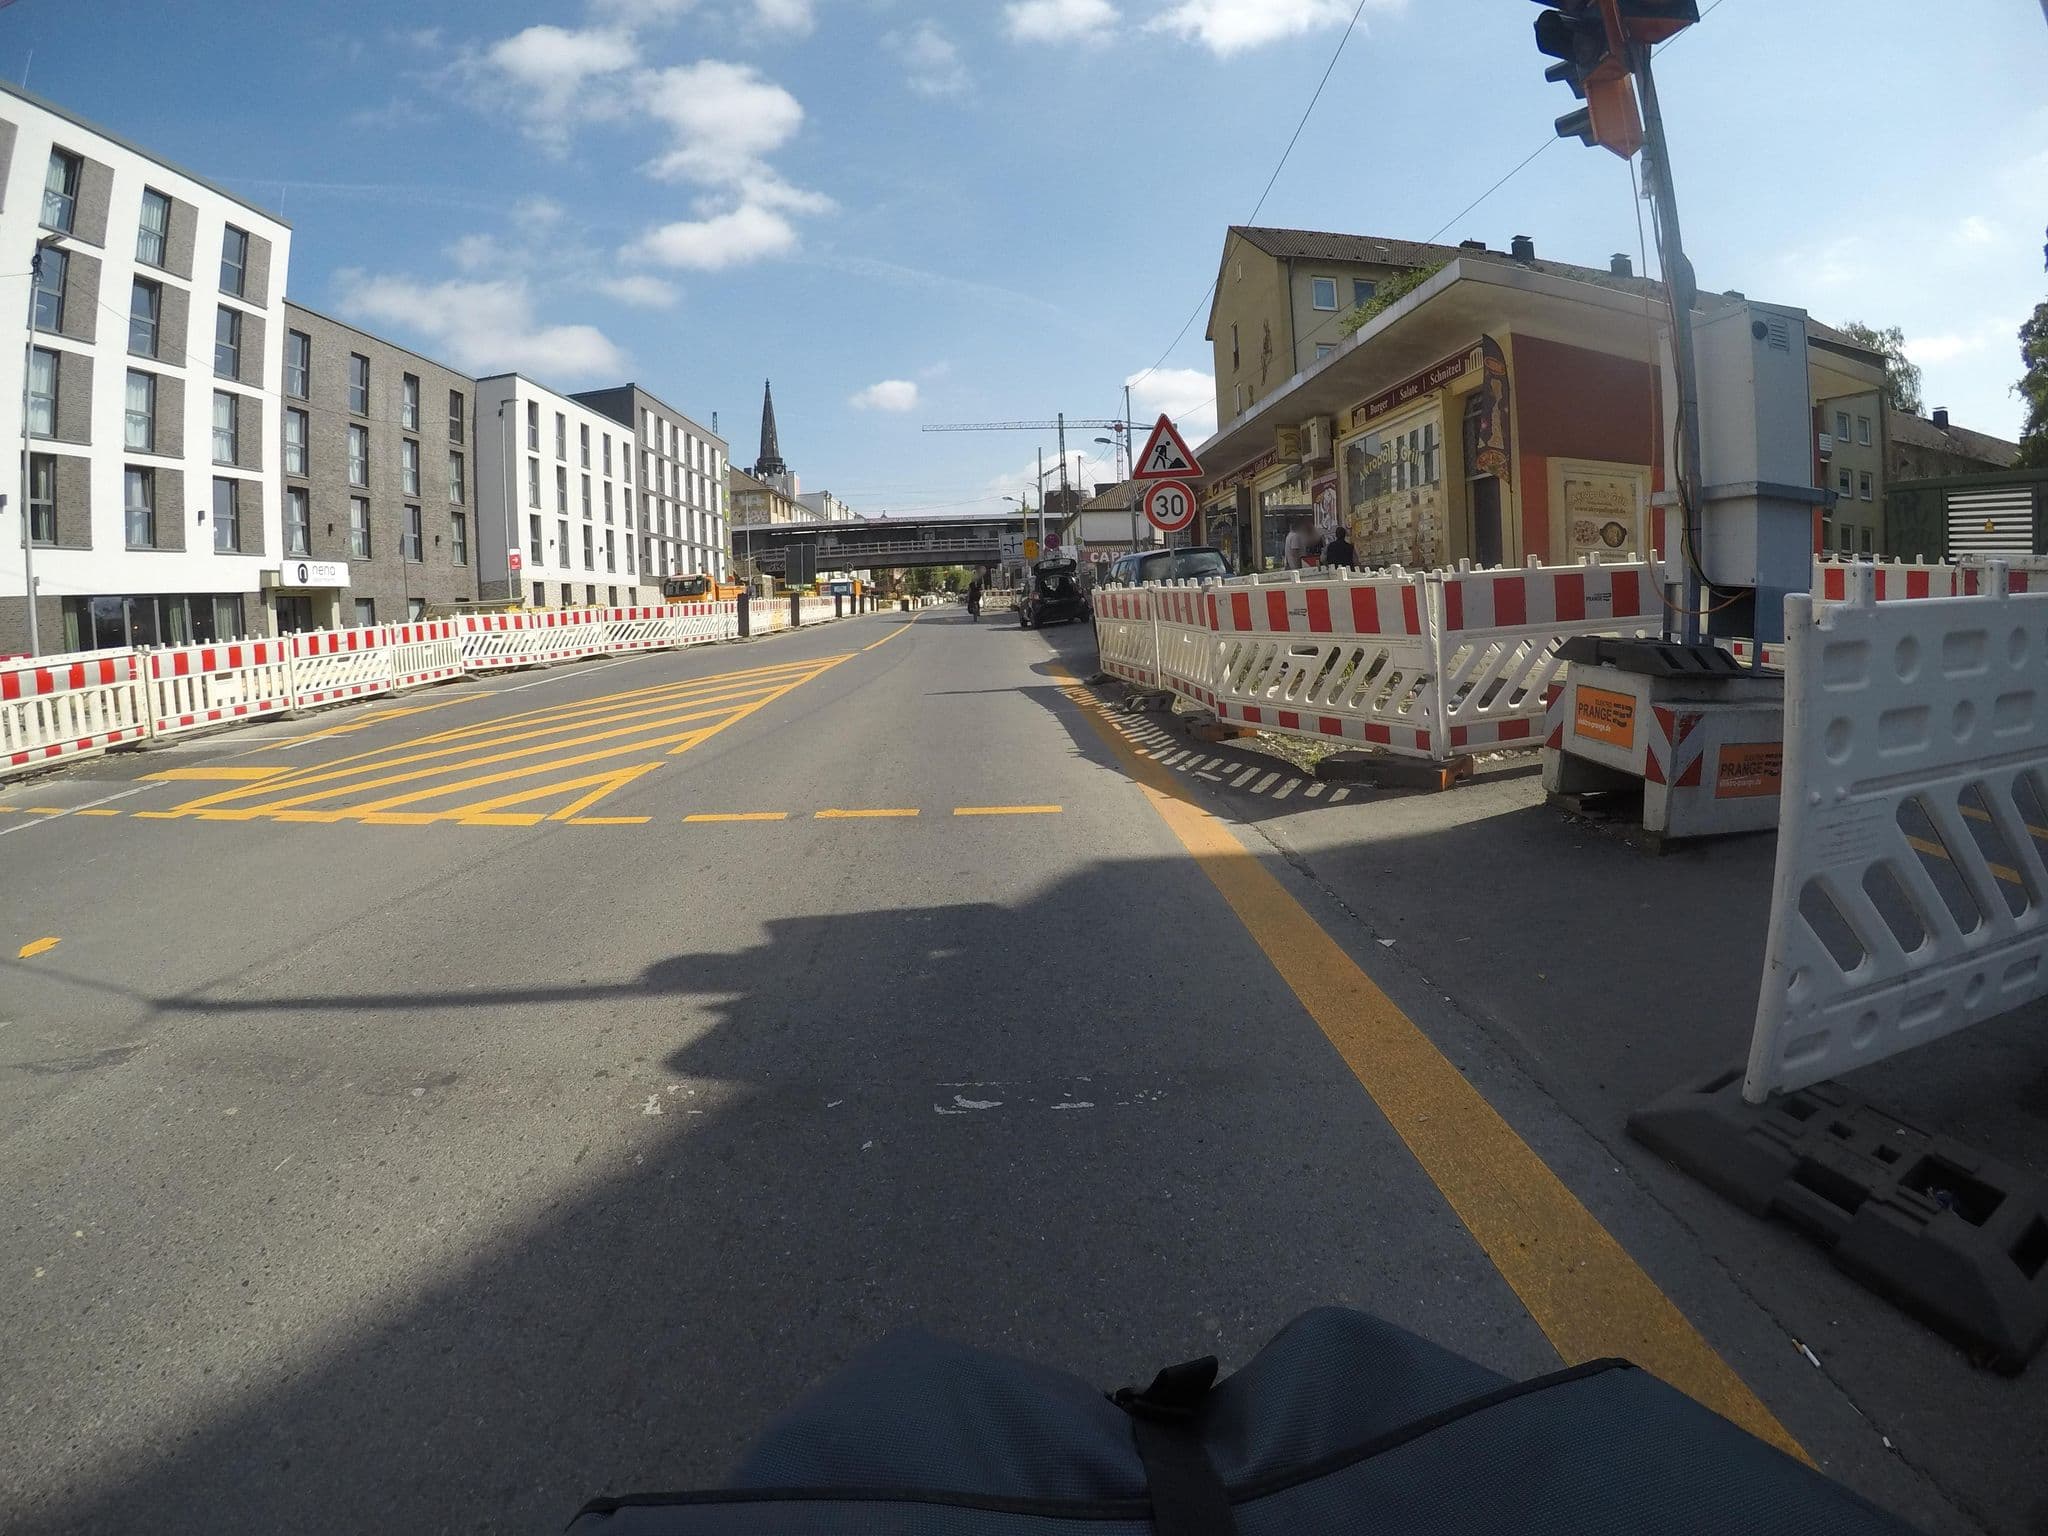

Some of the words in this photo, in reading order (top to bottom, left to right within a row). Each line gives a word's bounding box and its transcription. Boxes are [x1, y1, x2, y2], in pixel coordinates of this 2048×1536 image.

[1369, 399, 1388, 416] Burger
[1399, 385, 1418, 401] Salate
[1430, 359, 1461, 386] Schnitzel
[1155, 493, 1184, 518] 30
[1578, 702, 1612, 722] PRANGE
[1720, 761, 1763, 778] PRANGE
